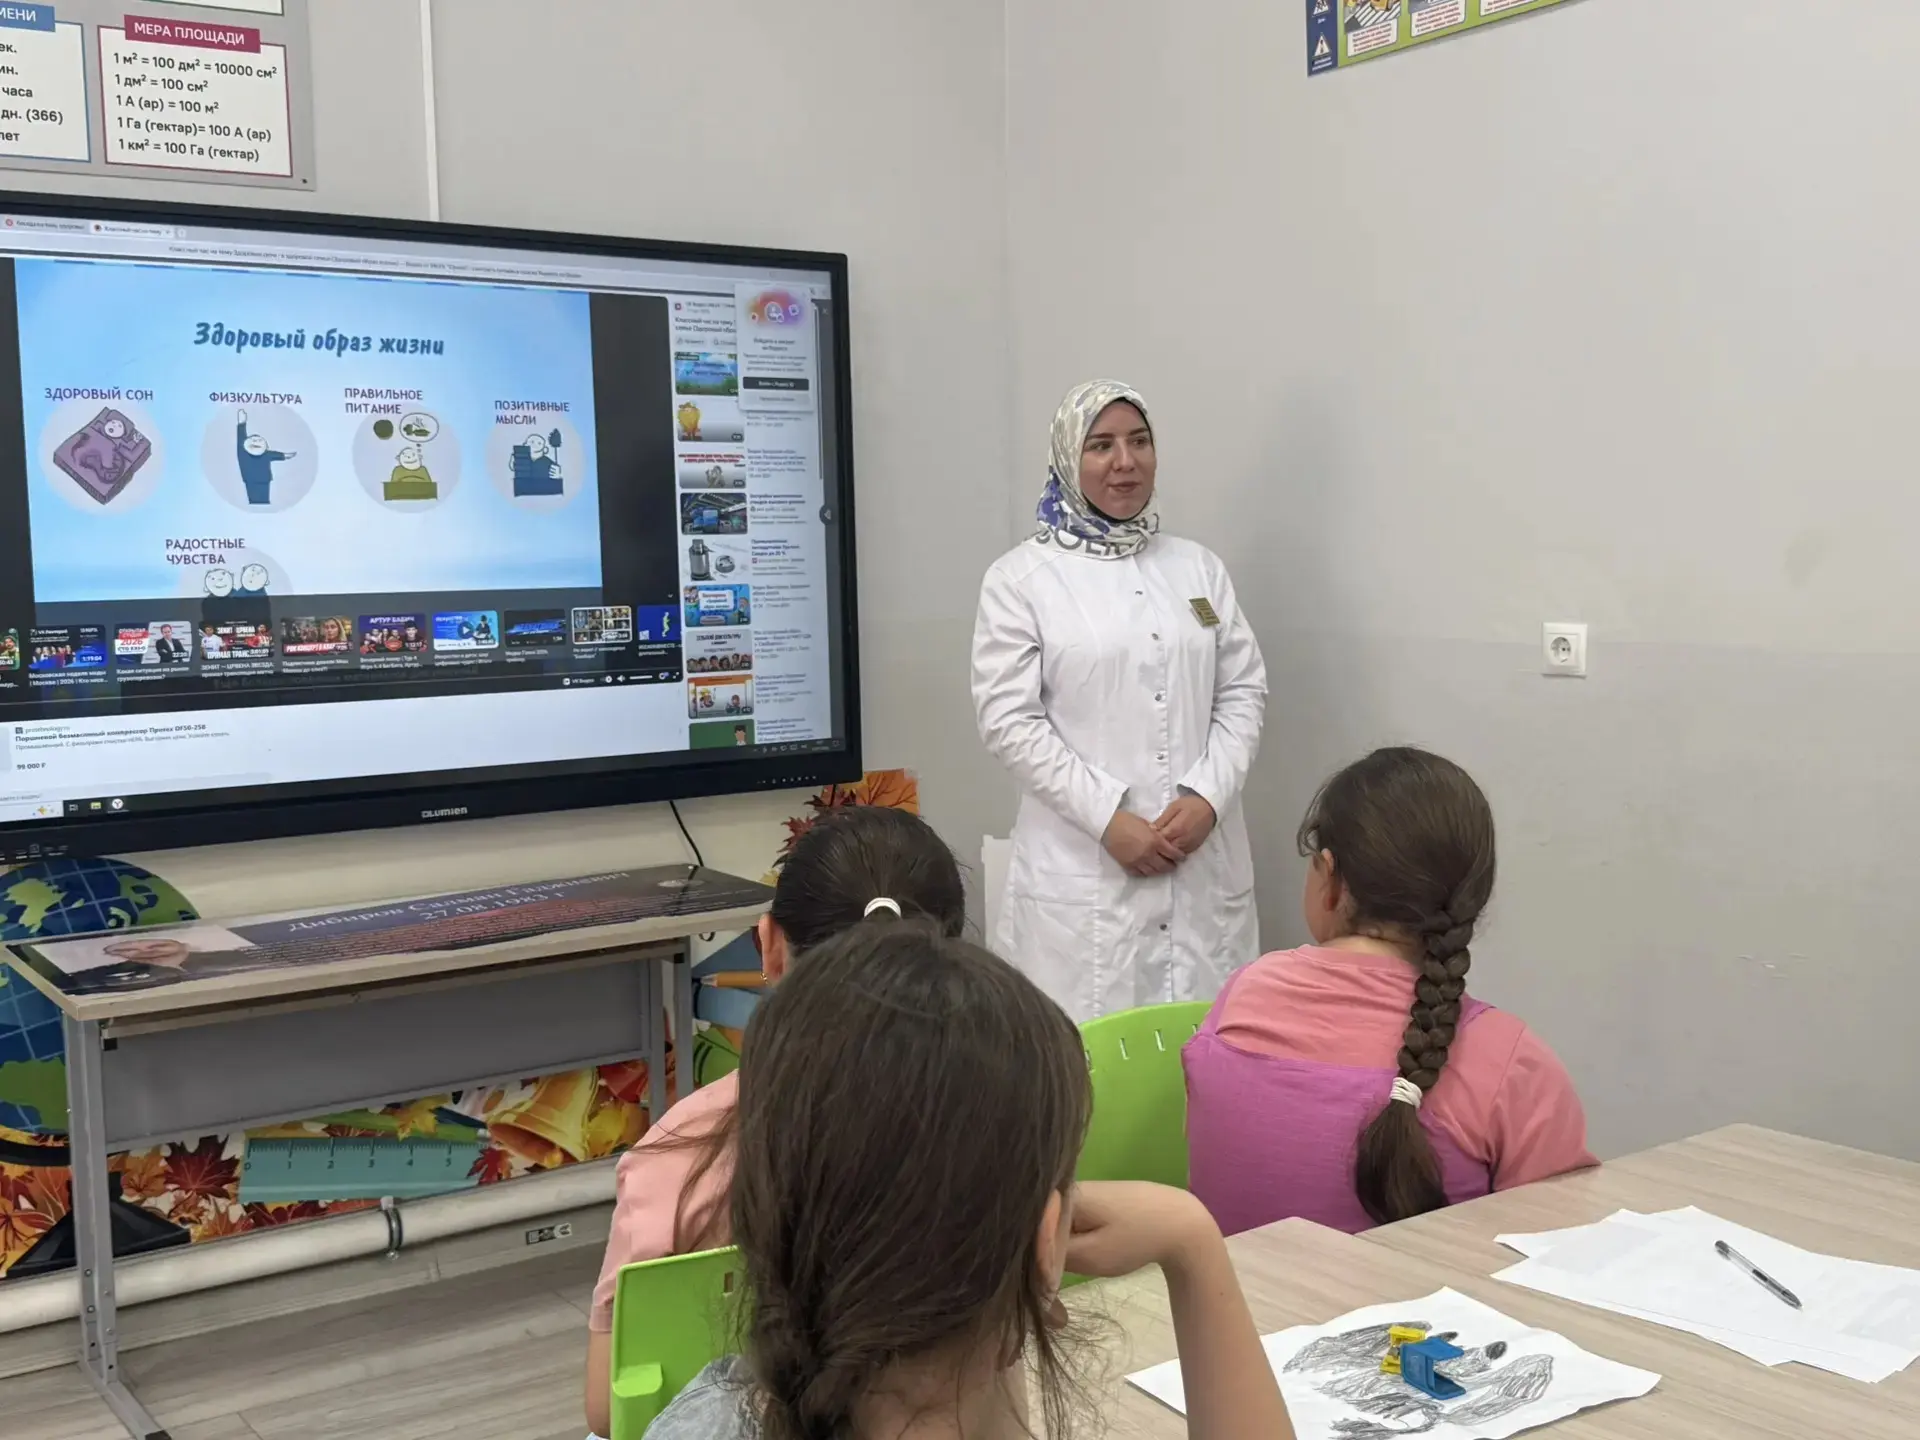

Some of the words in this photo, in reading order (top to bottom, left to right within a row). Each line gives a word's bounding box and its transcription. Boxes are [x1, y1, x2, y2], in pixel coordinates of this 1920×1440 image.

[134, 22, 171, 37] МЕРА
[174, 26, 245, 46] ПЛОЩАДИ
[113, 53, 120, 64] 1
[152, 57, 175, 69] 100
[215, 63, 253, 77] 10000
[115, 75, 121, 86] 1
[161, 78, 184, 91] 100
[2, 86, 33, 98] часа
[116, 95, 122, 107] 1
[139, 96, 164, 112] (ар)
[179, 100, 201, 113] 100
[1, 109, 22, 120] дн.
[26, 108, 63, 126] (366)
[117, 117, 124, 129] 1
[127, 117, 142, 130] Га
[209, 124, 231, 137] 100
[247, 126, 272, 142] (ар)
[118, 138, 125, 150] 1
[165, 142, 187, 155] 100
[190, 144, 205, 157] Га
[208, 145, 260, 163] (гектар)
[193, 322, 306, 354] Здоровый
[312, 328, 372, 358] образ
[378, 335, 445, 355] жизни
[44, 387, 122, 401] ЗДОРОВЫЙ
[125, 389, 153, 402] СОН
[209, 391, 303, 405] ФИЗКУЛЬТУРА
[344, 388, 424, 401] ПРАВИЛЬНОЕ
[345, 402, 402, 415] ПИТАНИЕ
[495, 400, 570, 413] ПОЗИТИВНЫЕ
[495, 414, 537, 426] МЫСЛИ
[165, 537, 246, 550] РАДОСТНЫЕ
[166, 553, 226, 566] ЧУВСТВА
[327, 1160, 335, 1169] 2
[368, 1159, 375, 1168] 3
[406, 1158, 414, 1167] 4
[445, 1158, 452, 1166] 5
